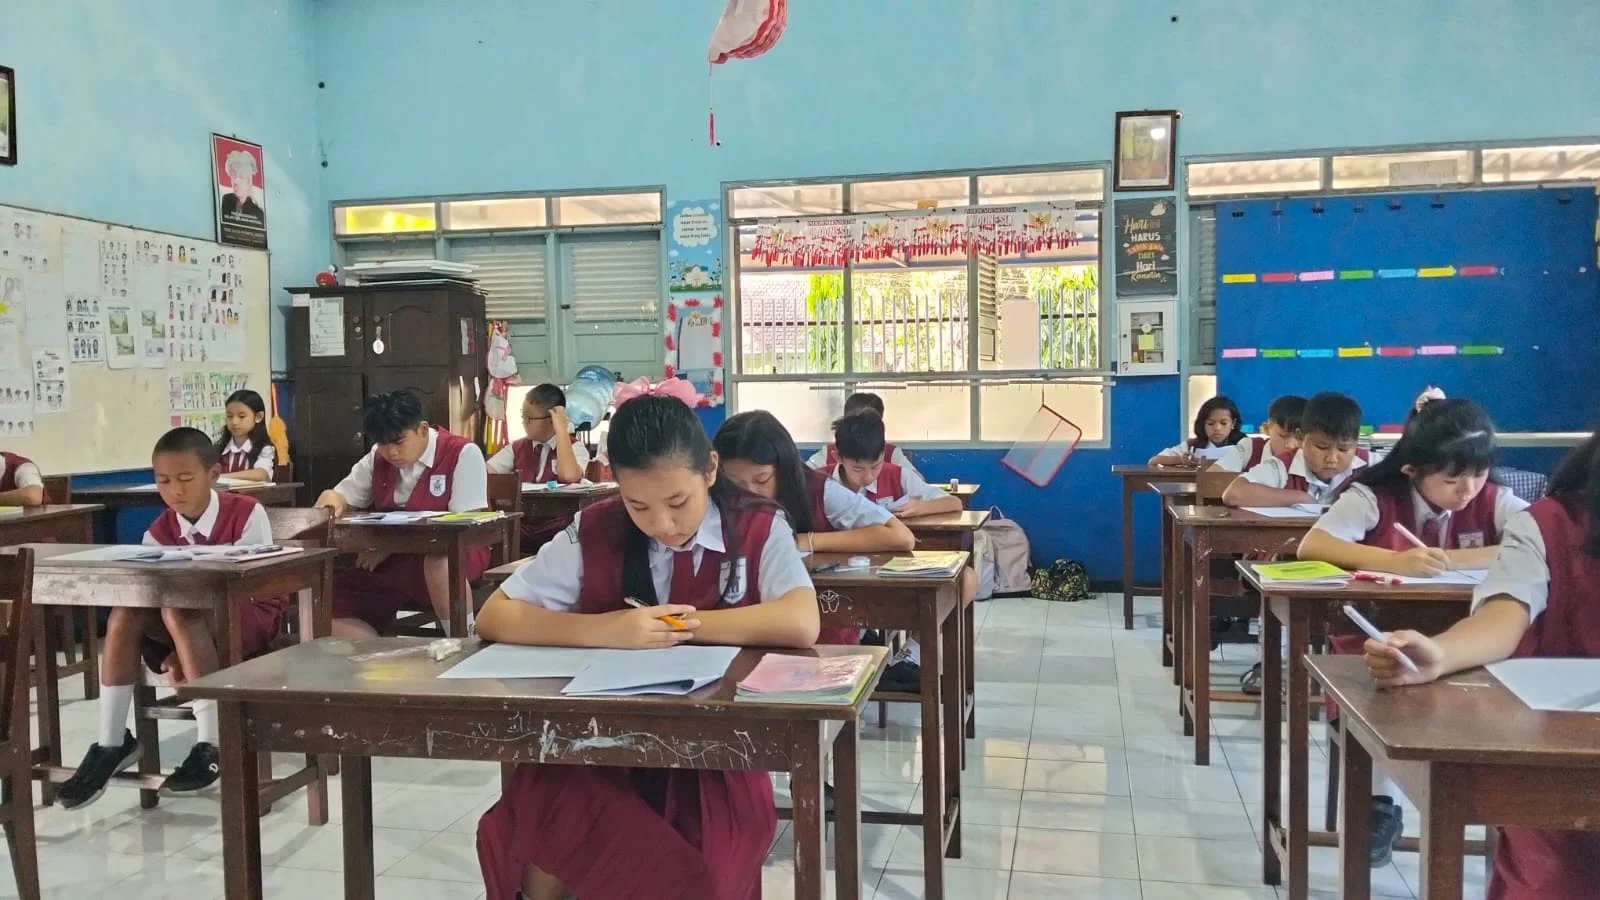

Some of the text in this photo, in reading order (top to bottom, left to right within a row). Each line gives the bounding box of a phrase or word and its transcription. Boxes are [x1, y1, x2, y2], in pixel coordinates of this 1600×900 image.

[1124, 218, 1148, 234] Hari
[1131, 231, 1161, 242] HARUS
[1136, 260, 1156, 272] Hari
